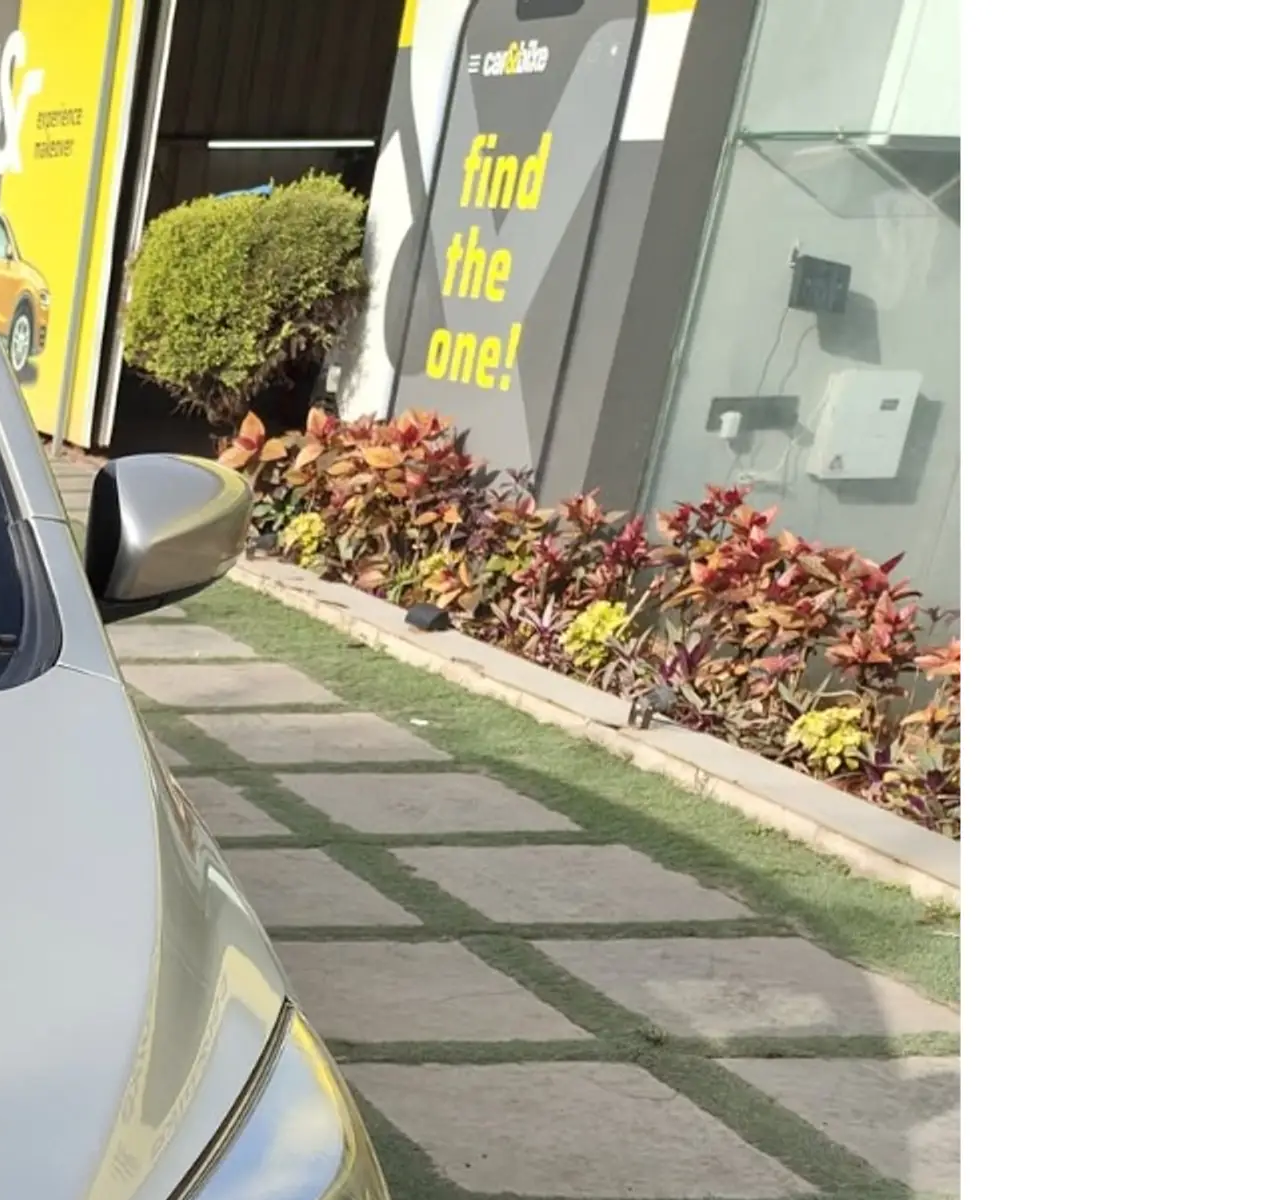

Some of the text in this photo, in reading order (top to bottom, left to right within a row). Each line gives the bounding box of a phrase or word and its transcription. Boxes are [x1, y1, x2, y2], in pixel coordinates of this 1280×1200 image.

[483, 39, 549, 76] car&bike
[36, 107, 83, 130] experience
[33, 139, 75, 159] makeover
[460, 131, 552, 210] find
[441, 226, 512, 303] the
[425, 322, 522, 391] one!
